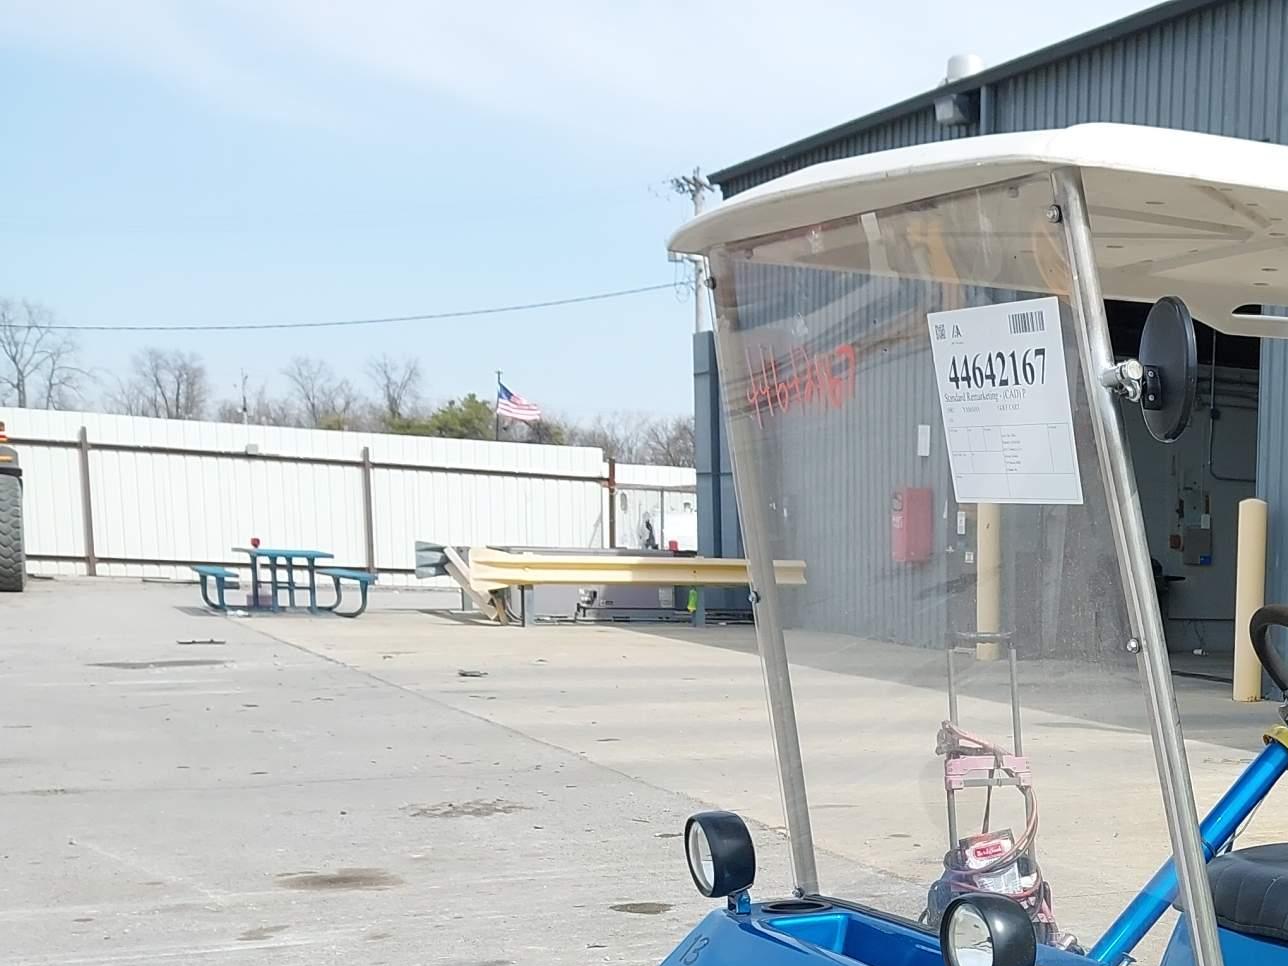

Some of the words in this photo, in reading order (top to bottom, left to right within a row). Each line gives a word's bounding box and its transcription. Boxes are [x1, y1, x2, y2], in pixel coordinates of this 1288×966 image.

[948, 348, 1047, 390] 44642167
[944, 392, 966, 402] Standard
[967, 391, 999, 402] Remarketing
[679, 934, 710, 966] 13
